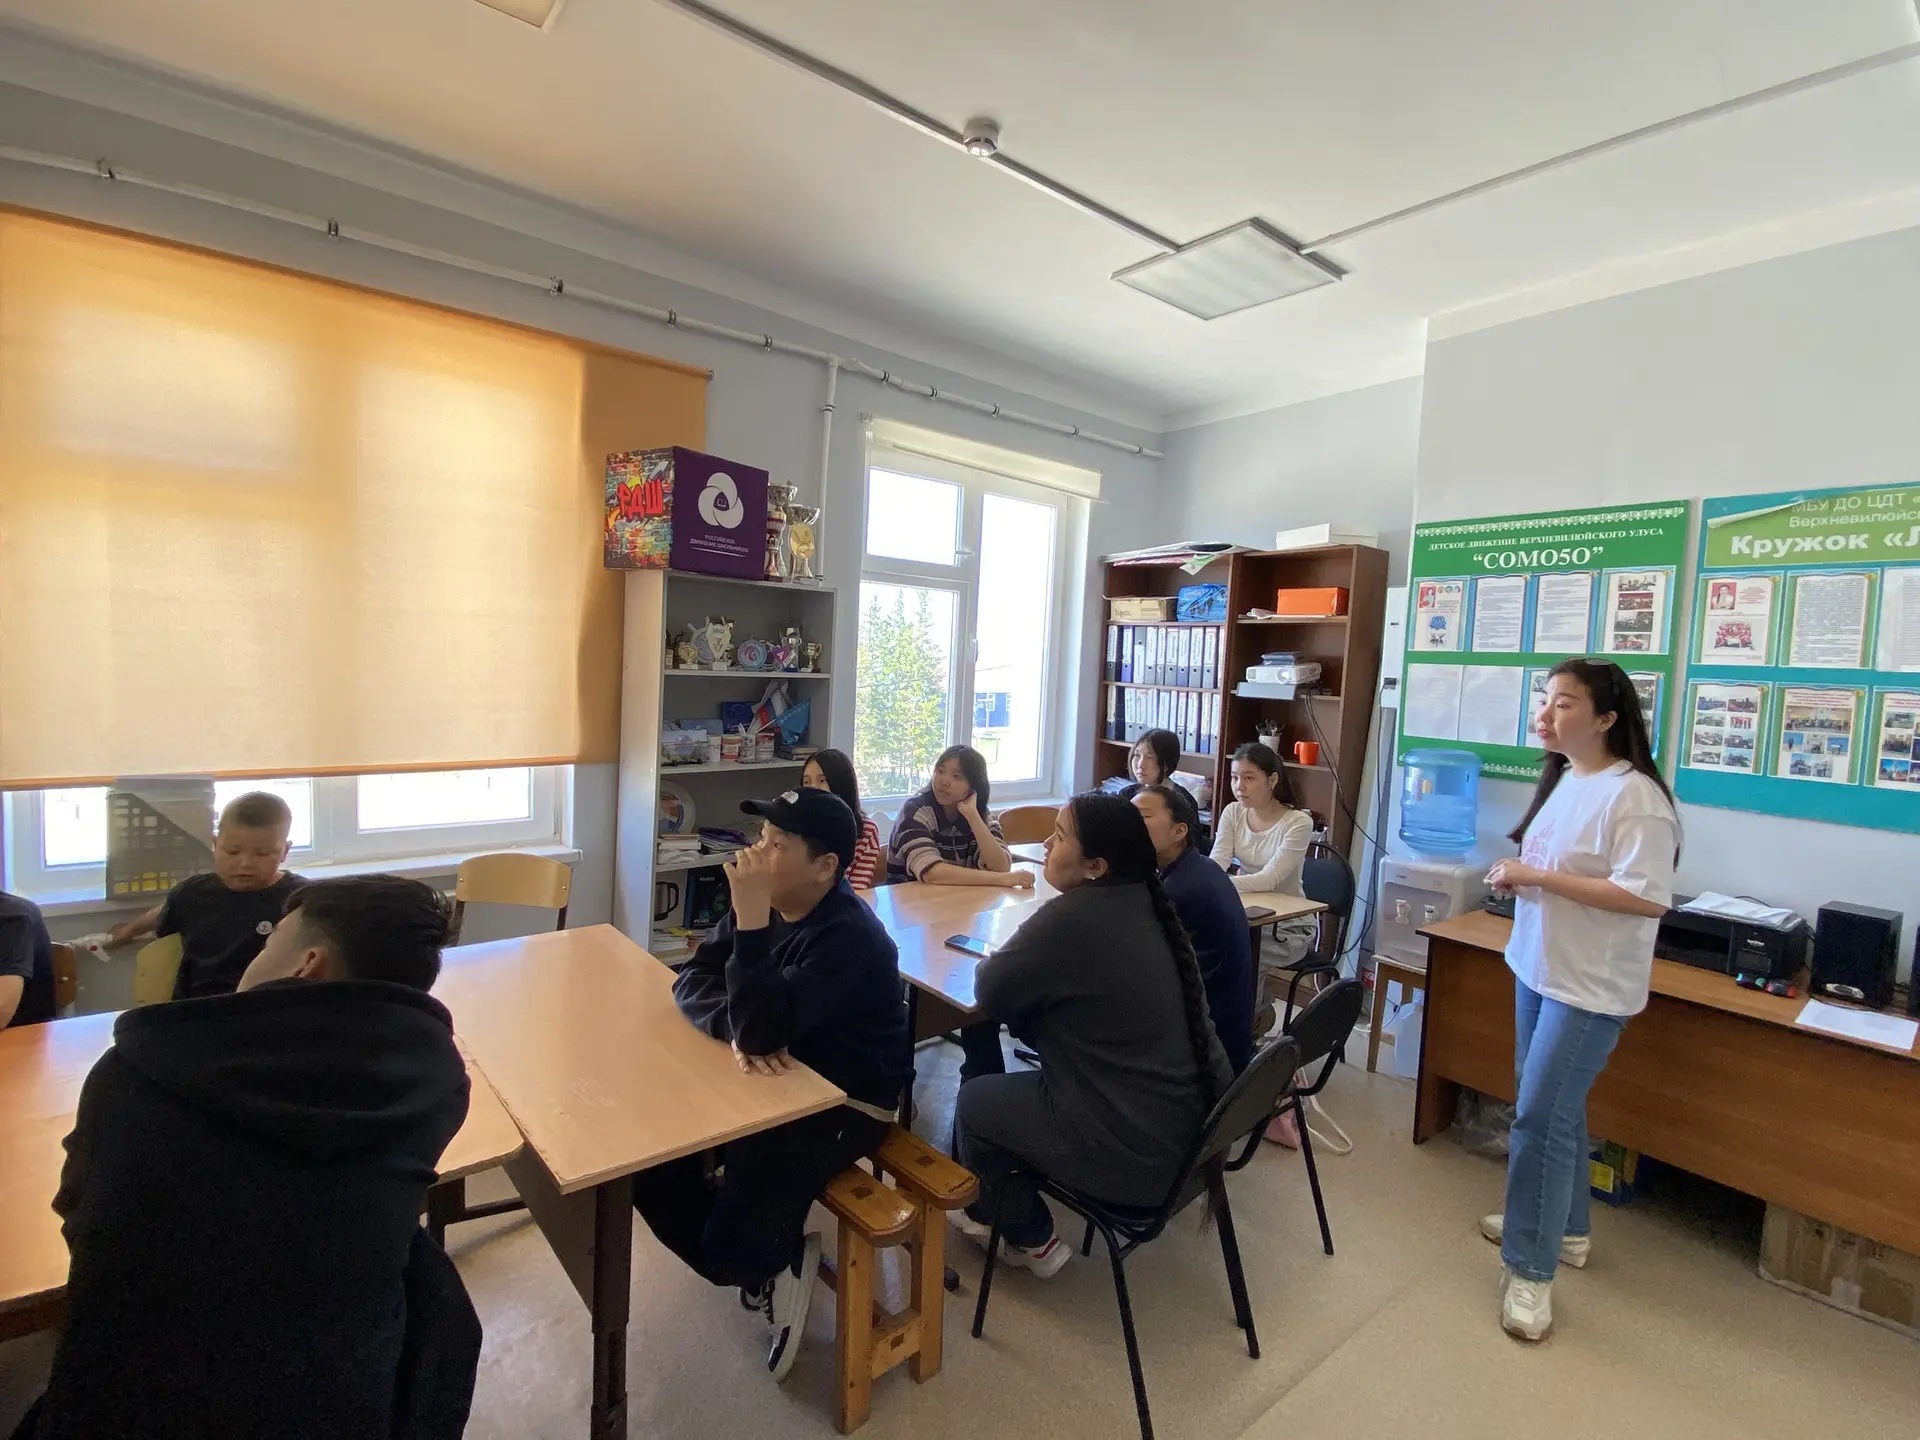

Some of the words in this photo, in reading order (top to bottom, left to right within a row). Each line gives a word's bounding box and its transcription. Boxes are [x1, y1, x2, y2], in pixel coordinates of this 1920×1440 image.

[616, 479, 663, 520] РДШ
[1833, 496, 1861, 511] ДО
[1868, 493, 1907, 508] ЦДТ
[1428, 541, 1465, 551] ДЕТСКОЕ
[1467, 538, 1517, 549] ДВИЖЕНИЕ
[1519, 530, 1626, 545] ВЕРХНЕВИЛЮЙСКОГО
[1629, 527, 1664, 538] УЛУСА
[1731, 533, 1869, 558] Кружок
